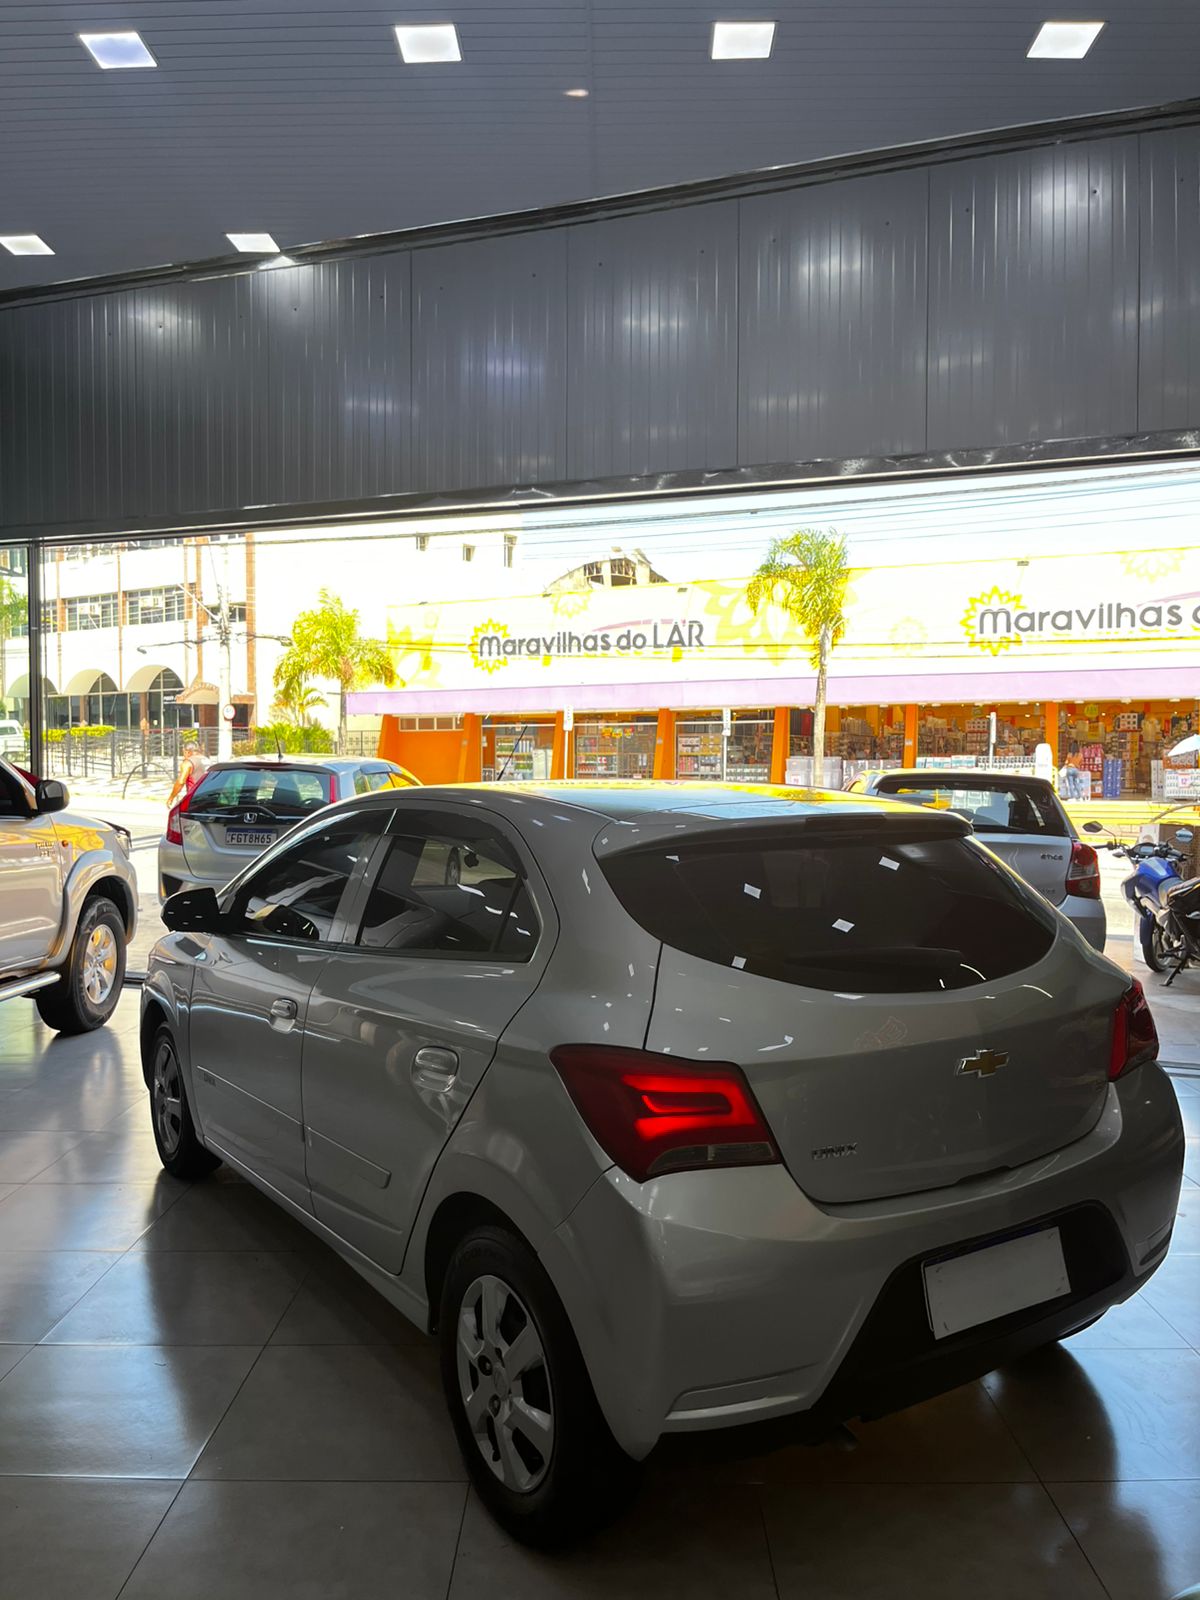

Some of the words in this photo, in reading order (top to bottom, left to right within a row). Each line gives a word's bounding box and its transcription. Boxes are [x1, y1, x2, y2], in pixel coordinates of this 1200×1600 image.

[616, 629, 647, 650] do
[653, 619, 705, 649] LAR
[230, 833, 272, 844] FGT8H65
